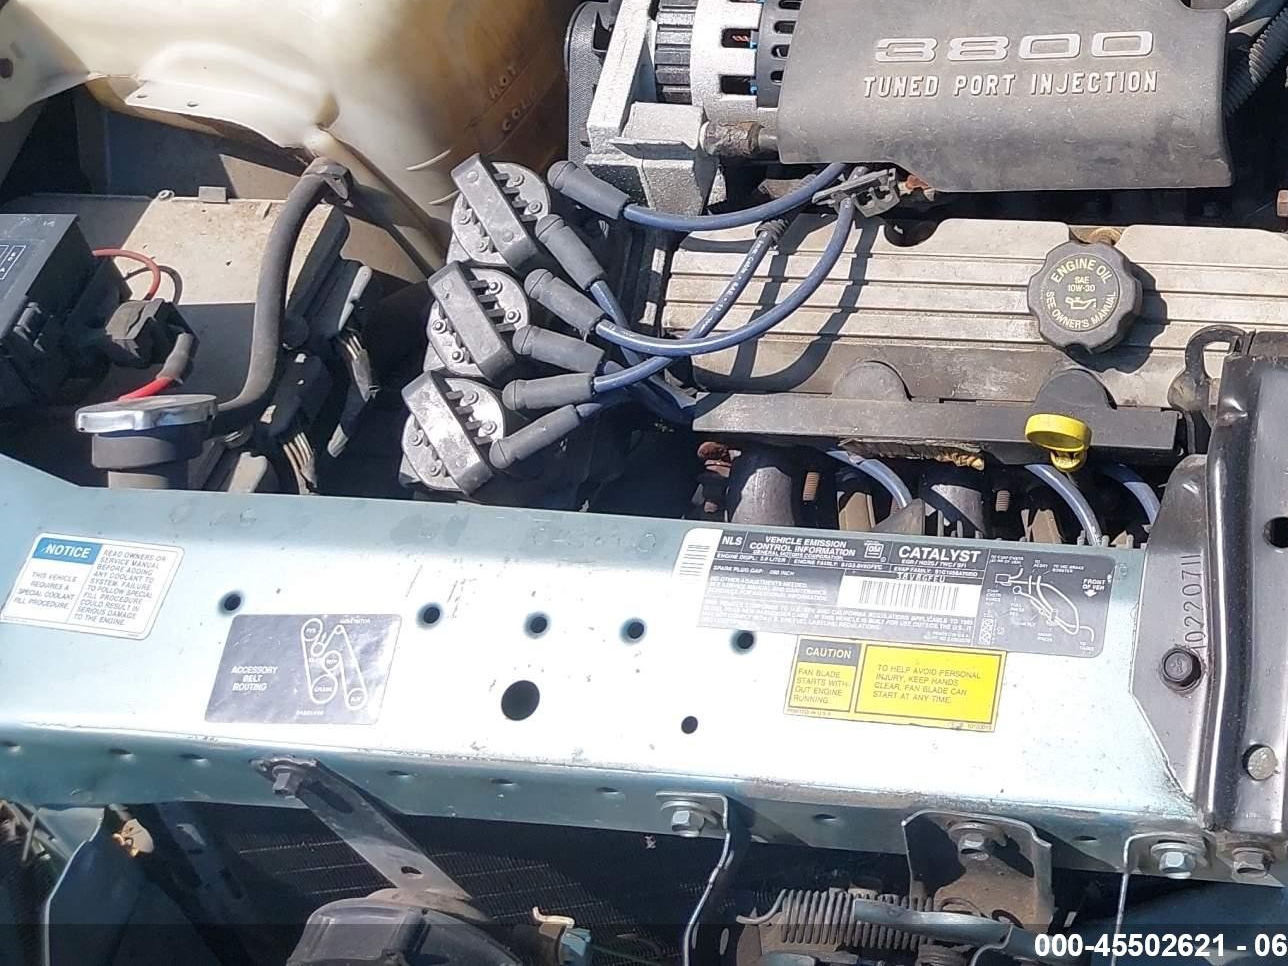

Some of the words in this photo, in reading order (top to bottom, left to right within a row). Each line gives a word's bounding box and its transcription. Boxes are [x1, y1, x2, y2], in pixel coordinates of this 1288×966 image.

[875, 30, 1154, 63] 3800
[863, 75, 939, 98] TUNED
[954, 73, 1016, 97] PORT
[1030, 70, 1159, 96] INJECTION
[1051, 258, 1097, 284] ENGINE
[1096, 265, 1113, 284] OIL
[1074, 276, 1090, 284] SAE
[1068, 284, 1096, 292] 10W-30
[1046, 291, 1056, 310] SEE
[1052, 308, 1090, 328] OWNER'S
[1090, 292, 1116, 325] MANUAL
[722, 536, 743, 546] NLS
[765, 536, 802, 546] VEHICLE
[804, 538, 847, 548] EMISSION
[44, 543, 91, 558] NOTICE
[104, 549, 123, 558] READ
[124, 552, 155, 561] OWNERS
[750, 542, 793, 552] CONTROL
[794, 546, 856, 557] INFORMATION
[898, 546, 981, 563] CATALYST
[100, 557, 129, 566] SERVICE
[131, 560, 159, 569] MANUAL
[96, 564, 125, 573] BEFORE
[126, 567, 154, 576] ADDING
[93, 570, 108, 578] ANY
[109, 572, 143, 582] COOLANT
[144, 576, 155, 584] TO
[1083, 578, 1106, 586] FRONT
[97, 586, 124, 595] FOLLOW
[125, 589, 152, 598] SPECIAL
[80, 598, 104, 608] COULD
[104, 602, 131, 611] RESULT
[99, 594, 143, 605] PROCEDURE
[76, 606, 106, 616] SERIOUS
[107, 610, 136, 620] DAMAGE
[84, 614, 98, 622] THE
[806, 647, 852, 659] CAUTION
[231, 666, 279, 674] ACCESSORY
[798, 668, 814, 676] FAN
[816, 670, 841, 678] BLADE
[878, 664, 889, 672] TO
[891, 666, 910, 674] HELP
[912, 667, 938, 676] AVOID
[940, 669, 982, 680] PERSONAL
[242, 674, 264, 683] BELT
[796, 678, 827, 686] STARTS
[908, 676, 929, 684] KEEP
[931, 677, 958, 686] HANDS
[232, 683, 268, 692] ROUTING
[795, 686, 811, 694] OUT
[814, 688, 842, 697] ENGINE
[904, 684, 921, 692] FAN
[923, 686, 948, 694] BLADE
[950, 688, 968, 696] CAN
[873, 690, 898, 700] START
[900, 692, 910, 700] AT
[912, 694, 929, 702] ANY
